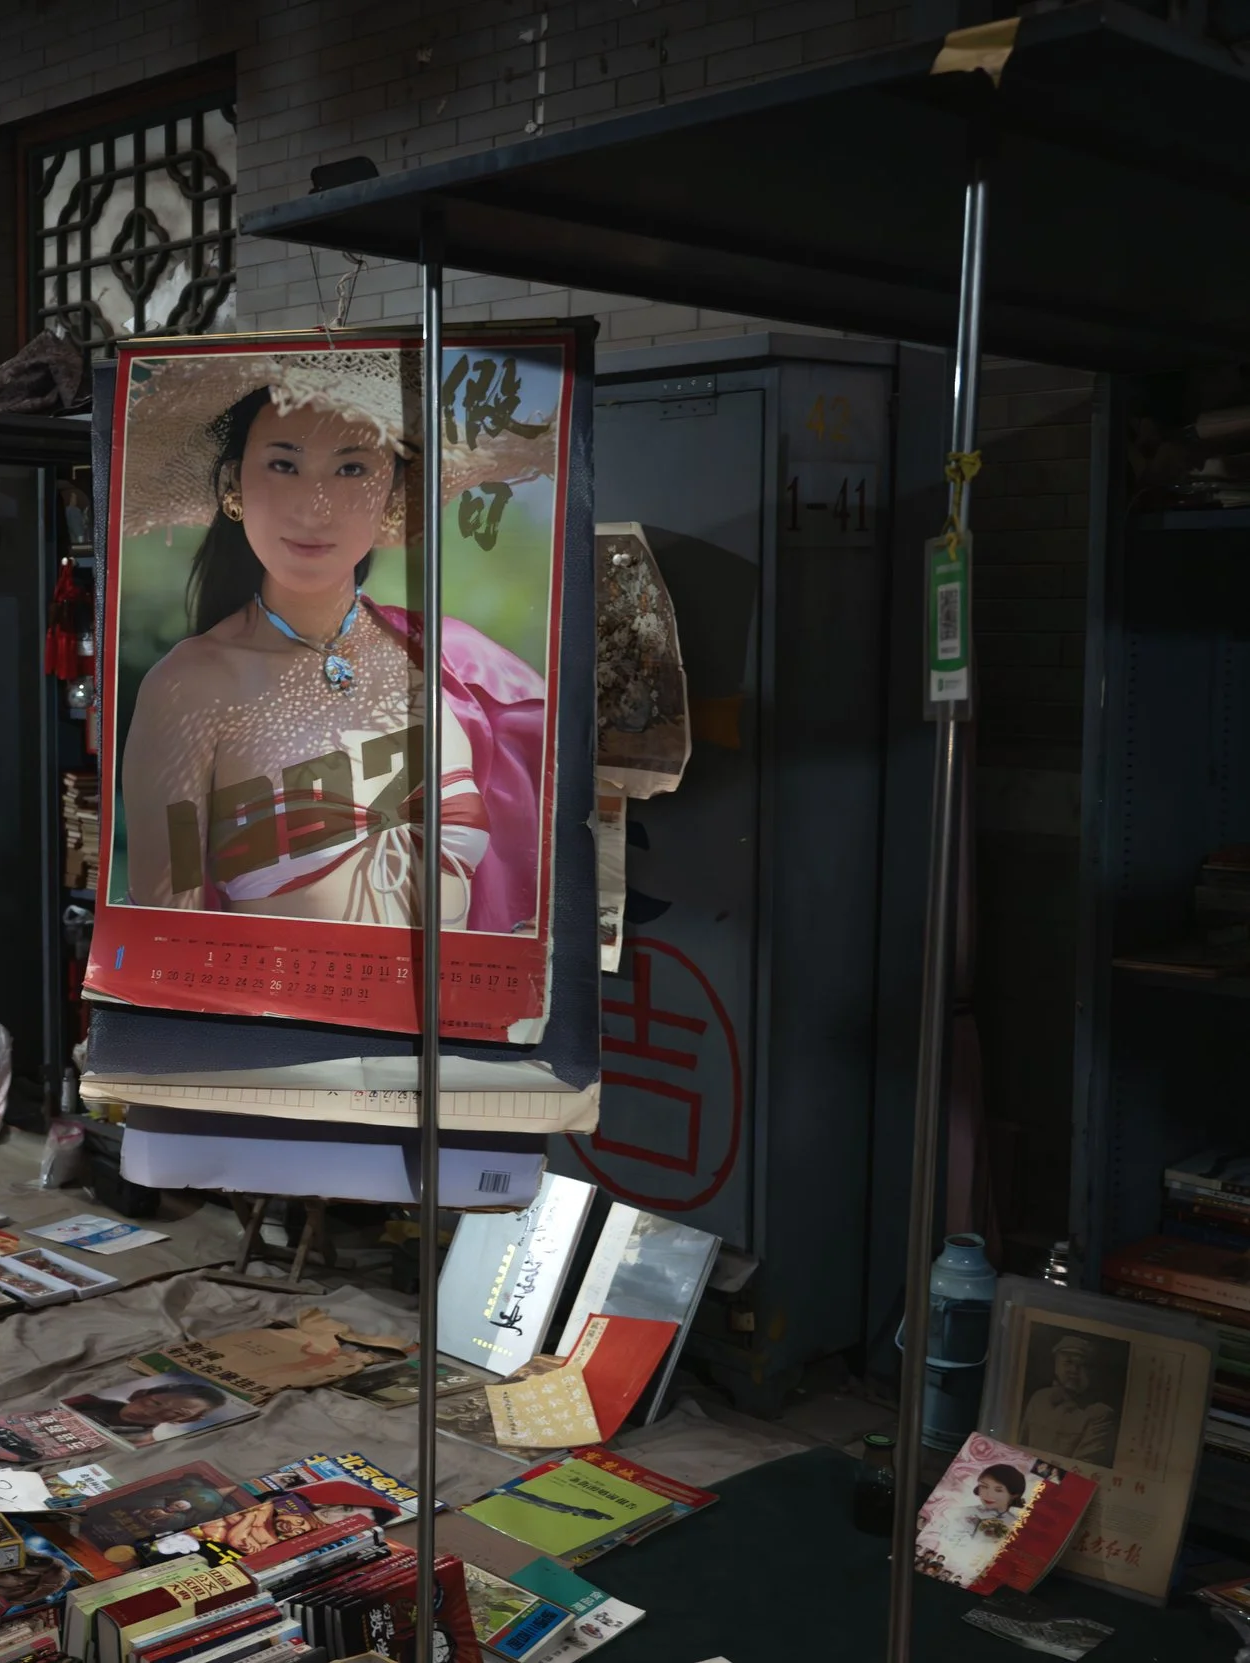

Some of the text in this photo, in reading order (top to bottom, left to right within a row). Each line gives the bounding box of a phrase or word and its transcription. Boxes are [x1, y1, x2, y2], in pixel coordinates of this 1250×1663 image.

[804, 394, 853, 445] 42
[442, 353, 552, 553] 假日
[785, 475, 871, 533] 1-41
[151, 969, 369, 998] 19 20 21 22 23 24 25 26 27 28 29 30 31
[361, 965, 373, 975] 10
[379, 966, 390, 976] 11
[397, 968, 408, 978] 12
[451, 972, 462, 982] 15
[469, 974, 481, 984] 16
[488, 976, 499, 986] 17
[507, 977, 518, 987] 18
[183, 1579, 206, 1597] 实用
[200, 1574, 219, 1591] 公文
[211, 1570, 232, 1587] 中国
[167, 1583, 191, 1600] 大典
